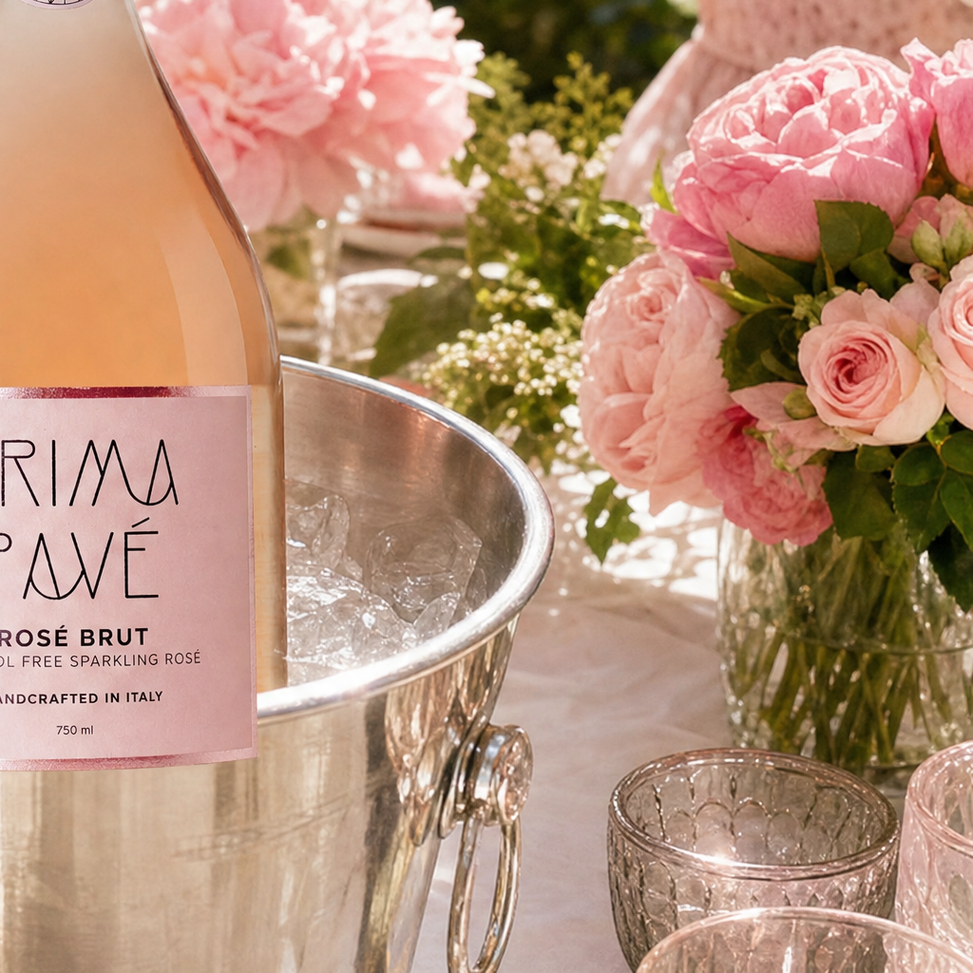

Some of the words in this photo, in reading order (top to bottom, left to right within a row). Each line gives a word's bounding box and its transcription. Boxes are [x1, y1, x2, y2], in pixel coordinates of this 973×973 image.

[80, 627, 149, 646] BRUT
[22, 654, 63, 668] FREE
[70, 653, 158, 667] SPARKLING
[164, 649, 201, 665] ROSÉ
[104, 692, 120, 704] IN
[126, 690, 163, 703] ITALY
[56, 724, 78, 736] 750
[80, 724, 94, 736] ml
